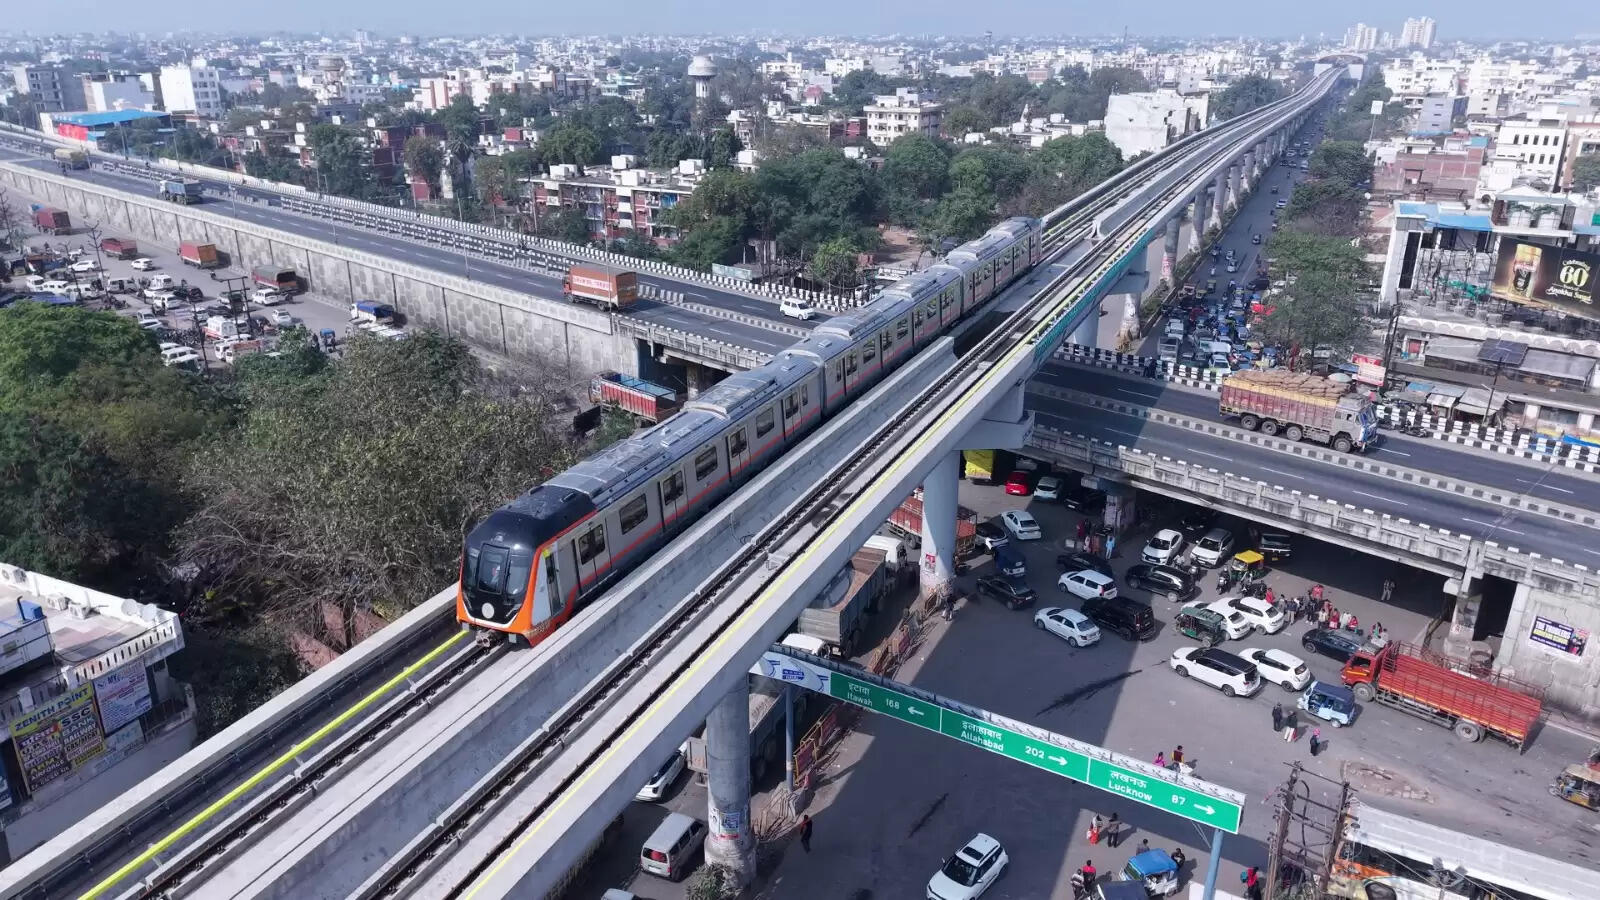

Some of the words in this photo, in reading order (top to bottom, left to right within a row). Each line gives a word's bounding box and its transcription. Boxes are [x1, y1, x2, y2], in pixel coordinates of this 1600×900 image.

[1560, 265, 1589, 287] 60
[14, 705, 56, 732] ZENITH
[57, 687, 89, 709] POINT
[886, 698, 900, 710] 168
[62, 707, 91, 727] SSC
[62, 714, 96, 737] BANK
[64, 721, 97, 745] RAILWAY
[961, 721, 1003, 741] इलाहाबाद
[960, 730, 1004, 752] Allahabad
[1024, 745, 1045, 759] 202
[1109, 770, 1148, 789] लखनऊ
[1108, 780, 1153, 801] Lucknow
[1171, 794, 1187, 806] 87
